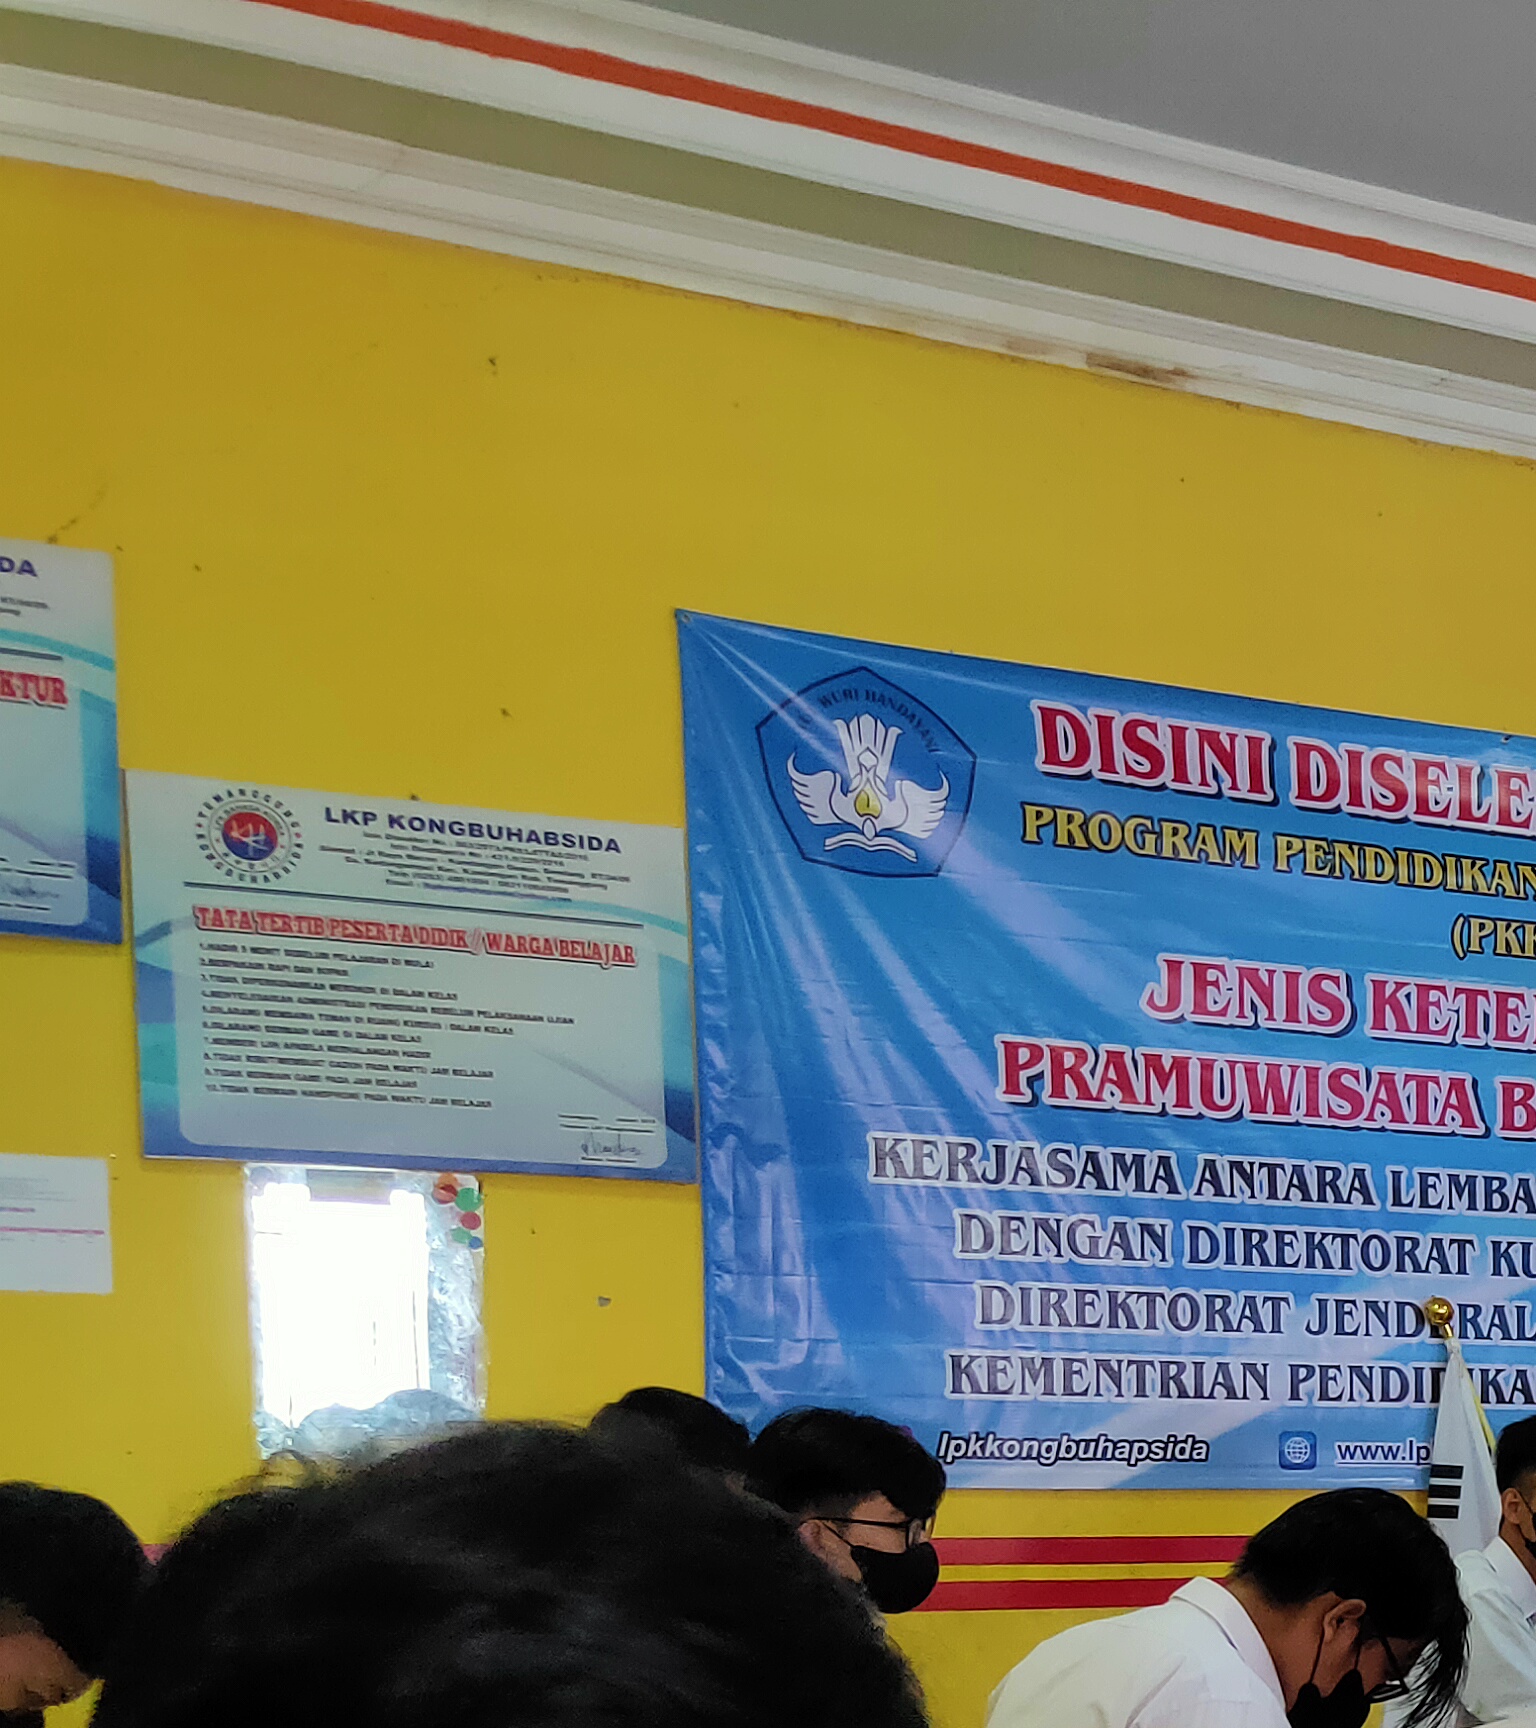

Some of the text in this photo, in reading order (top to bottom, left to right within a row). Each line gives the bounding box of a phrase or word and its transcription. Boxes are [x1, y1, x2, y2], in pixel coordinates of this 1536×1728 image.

[0, 670, 68, 705] KTUR
[1035, 704, 1272, 799] DISINI
[325, 806, 377, 826] LKP
[388, 813, 622, 854] KONGBUHABSIDA
[1022, 802, 1258, 869] PROGRAM
[195, 905, 253, 931] TATA
[255, 911, 325, 938] TERTIB
[329, 919, 412, 946] PESERTA
[417, 926, 470, 949] DIDIK
[484, 931, 556, 958] WARGA
[557, 938, 637, 967] BELAJAR
[1146, 955, 1346, 1031] JENIS
[998, 1039, 1481, 1134] PRAMUWISATA
[869, 1134, 1181, 1196] KERJASAMA
[1195, 1158, 1379, 1208] ANTARA
[956, 1211, 1169, 1264] DENGAN
[1187, 1223, 1475, 1277] DIREKTORAT
[979, 1284, 1291, 1335] DIREKTORAT
[948, 1354, 1269, 1401] KEMENTRIAN
[937, 1431, 1210, 1464] lpkkongbuhapsida
[1337, 1440, 1432, 1466] www.lp
